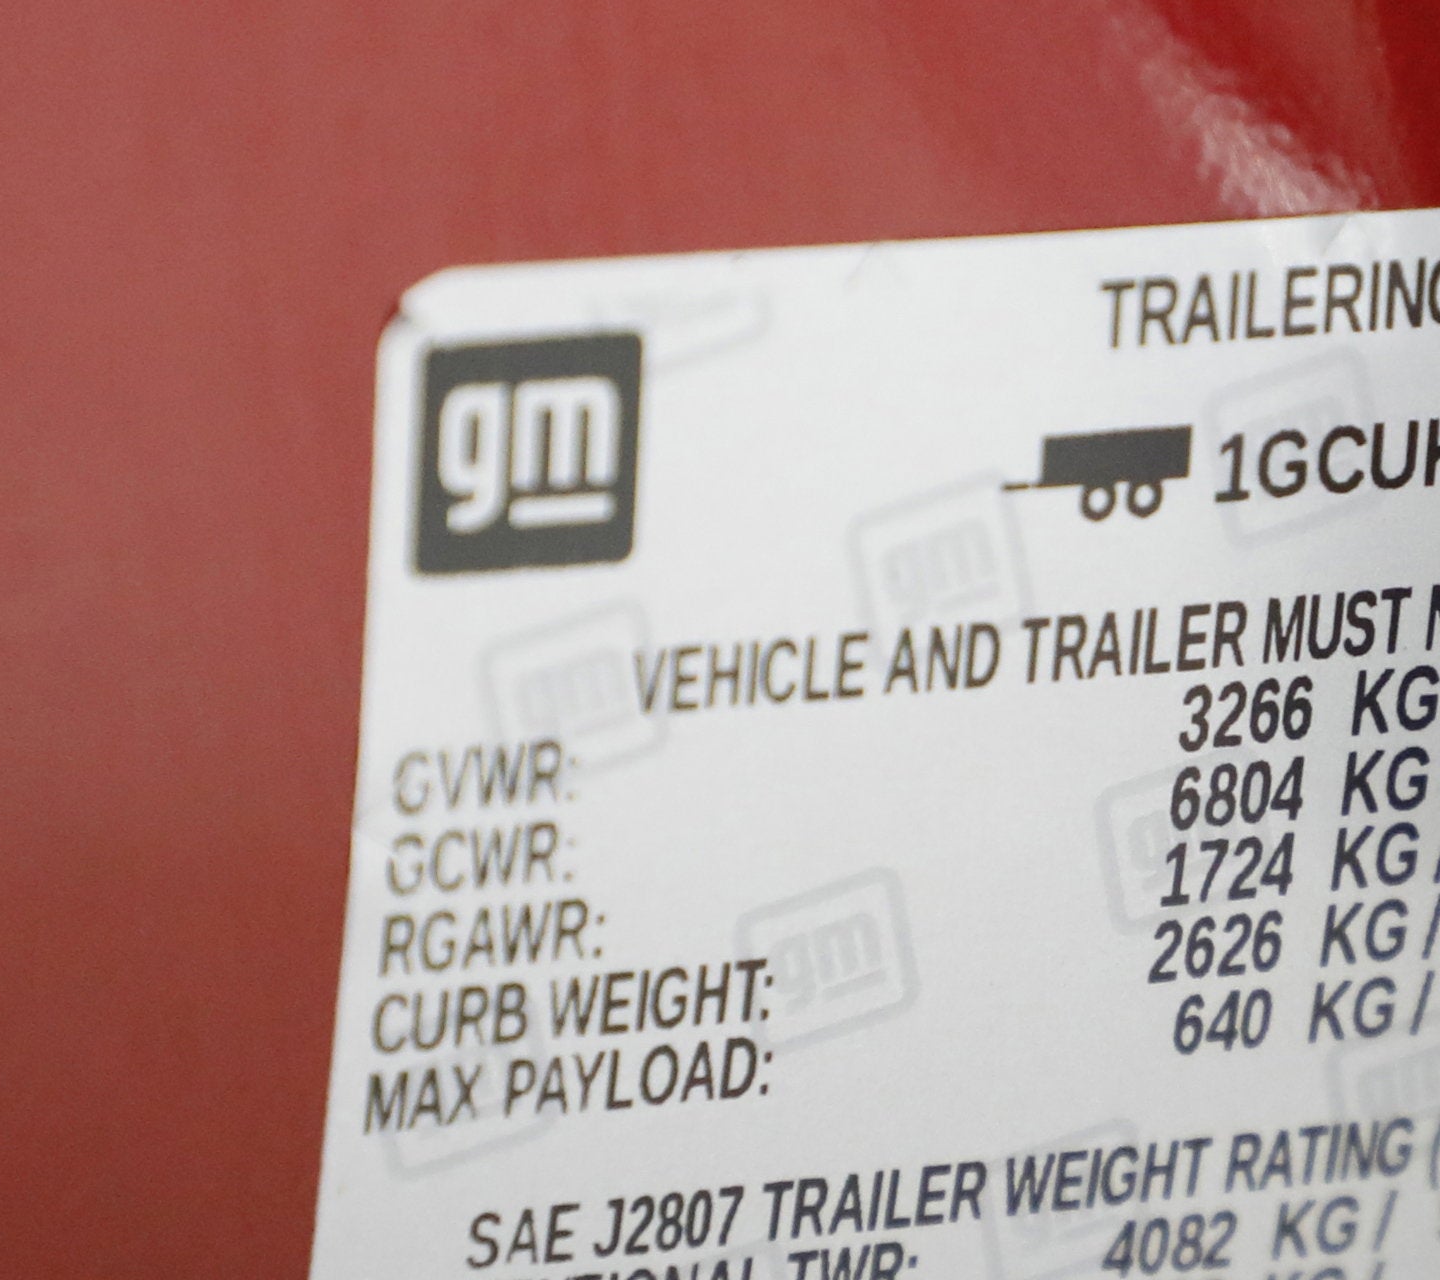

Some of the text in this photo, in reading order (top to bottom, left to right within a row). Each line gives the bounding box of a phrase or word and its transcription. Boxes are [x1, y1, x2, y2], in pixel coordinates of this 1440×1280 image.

[437, 375, 618, 534] gm
[631, 627, 872, 715] VEHICLE
[881, 619, 1002, 694] AND
[1019, 597, 1249, 684] TRAILER
[1259, 583, 1414, 665] MUST
[390, 734, 581, 818] GVWR:
[1175, 672, 1314, 754] 3266
[1167, 752, 1306, 832] 6804
[376, 895, 606, 977] RGAWR:
[1157, 829, 1296, 908] 1724
[368, 978, 530, 1056] CURB
[548, 954, 775, 1037] WEIGHT:
[1144, 907, 1284, 985] 2626
[361, 1063, 484, 1134] MAX
[501, 1033, 774, 1116] PAYLOAD:
[1170, 985, 1274, 1056] 640
[463, 1199, 581, 1271] SAE
[590, 1182, 746, 1259] J2807
[760, 1157, 989, 1242] TRAILER
[1002, 1134, 1214, 1218] WEIGHT
[1222, 1113, 1416, 1194] RATING
[1098, 1206, 1239, 1279] 4082
